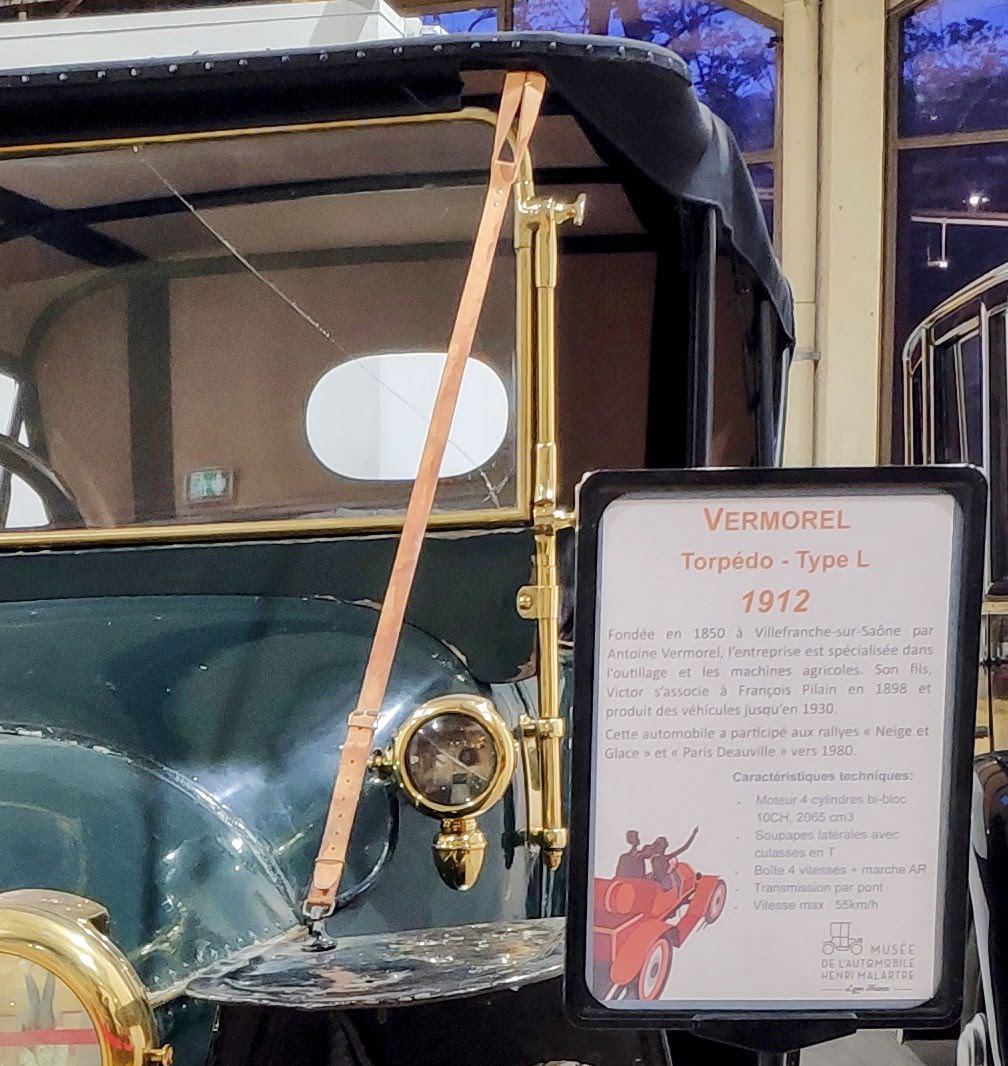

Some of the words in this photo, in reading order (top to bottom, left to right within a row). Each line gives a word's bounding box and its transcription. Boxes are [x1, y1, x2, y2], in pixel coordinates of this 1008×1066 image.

[704, 508, 850, 531] VERMOREL
[681, 552, 773, 573] Torpédo
[797, 551, 849, 573] Type
[857, 550, 869, 568] L
[743, 589, 810, 613] 1912
[608, 629, 655, 640] Fondée
[666, 630, 681, 639] en
[694, 628, 725, 639] 1850
[736, 627, 743, 638] à
[755, 626, 901, 638] Villefranche-sur-Saône
[912, 627, 934, 638] par
[607, 648, 657, 659] Antoine
[661, 647, 724, 659] Vermorel,
[805, 647, 824, 656] est
[828, 645, 898, 657] spécialisée
[903, 645, 933, 655] dans
[679, 668, 691, 677] et
[702, 666, 719, 677] les
[731, 666, 792, 677] machines
[803, 665, 863, 678] agricoles.
[875, 664, 898, 675] Son
[910, 663, 932, 676] fils,
[607, 686, 643, 698] Victor
[720, 685, 727, 696] à
[738, 685, 791, 698] François
[803, 684, 837, 695] Pilain
[848, 686, 864, 694] en
[876, 683, 907, 694] 1898
[918, 684, 931, 694] et
[606, 706, 651, 719] produit
[656, 706, 678, 717] des
[682, 704, 740, 716] véhicules
[803, 703, 838, 714] 1930.
[605, 729, 638, 740] Cette
[643, 728, 715, 740] automobile
[719, 730, 726, 738] a
[731, 727, 787, 740] participé
[792, 728, 813, 737] aux
[819, 727, 859, 739] rallyes
[876, 726, 912, 739] Neige
[917, 727, 929, 736] et
[605, 748, 639, 759] Glace
[655, 749, 666, 758] et
[683, 747, 713, 758] Paris
[717, 746, 775, 757] Deauville
[791, 748, 817, 756] vers
[821, 745, 855, 756] 1980.
[733, 772, 835, 783] Caractéristiques
[756, 795, 797, 805] Moteur
[800, 795, 807, 804] 4
[812, 794, 863, 807] cylindres
[868, 794, 907, 804] bi-bloc
[797, 812, 825, 822] 2065
[829, 813, 854, 822] cm3
[756, 830, 814, 842] Soupapes
[818, 830, 867, 840] latérales
[871, 831, 899, 839] avec
[755, 848, 805, 858] culasses
[809, 849, 823, 857] en
[828, 847, 835, 857] T
[754, 865, 784, 875] Boîte
[788, 865, 795, 874] 4
[800, 865, 846, 875] vitesses
[862, 864, 906, 874] marche
[909, 864, 927, 874] AR
[754, 883, 831, 893] Transmission
[835, 884, 853, 894] par
[858, 883, 883, 893] pont
[754, 900, 795, 910] Vitesse
[835, 900, 878, 910] 55km/h
[871, 942, 915, 955] MUSÉE
[822, 959, 835, 968] DE
[821, 971, 854, 980] HENRI
